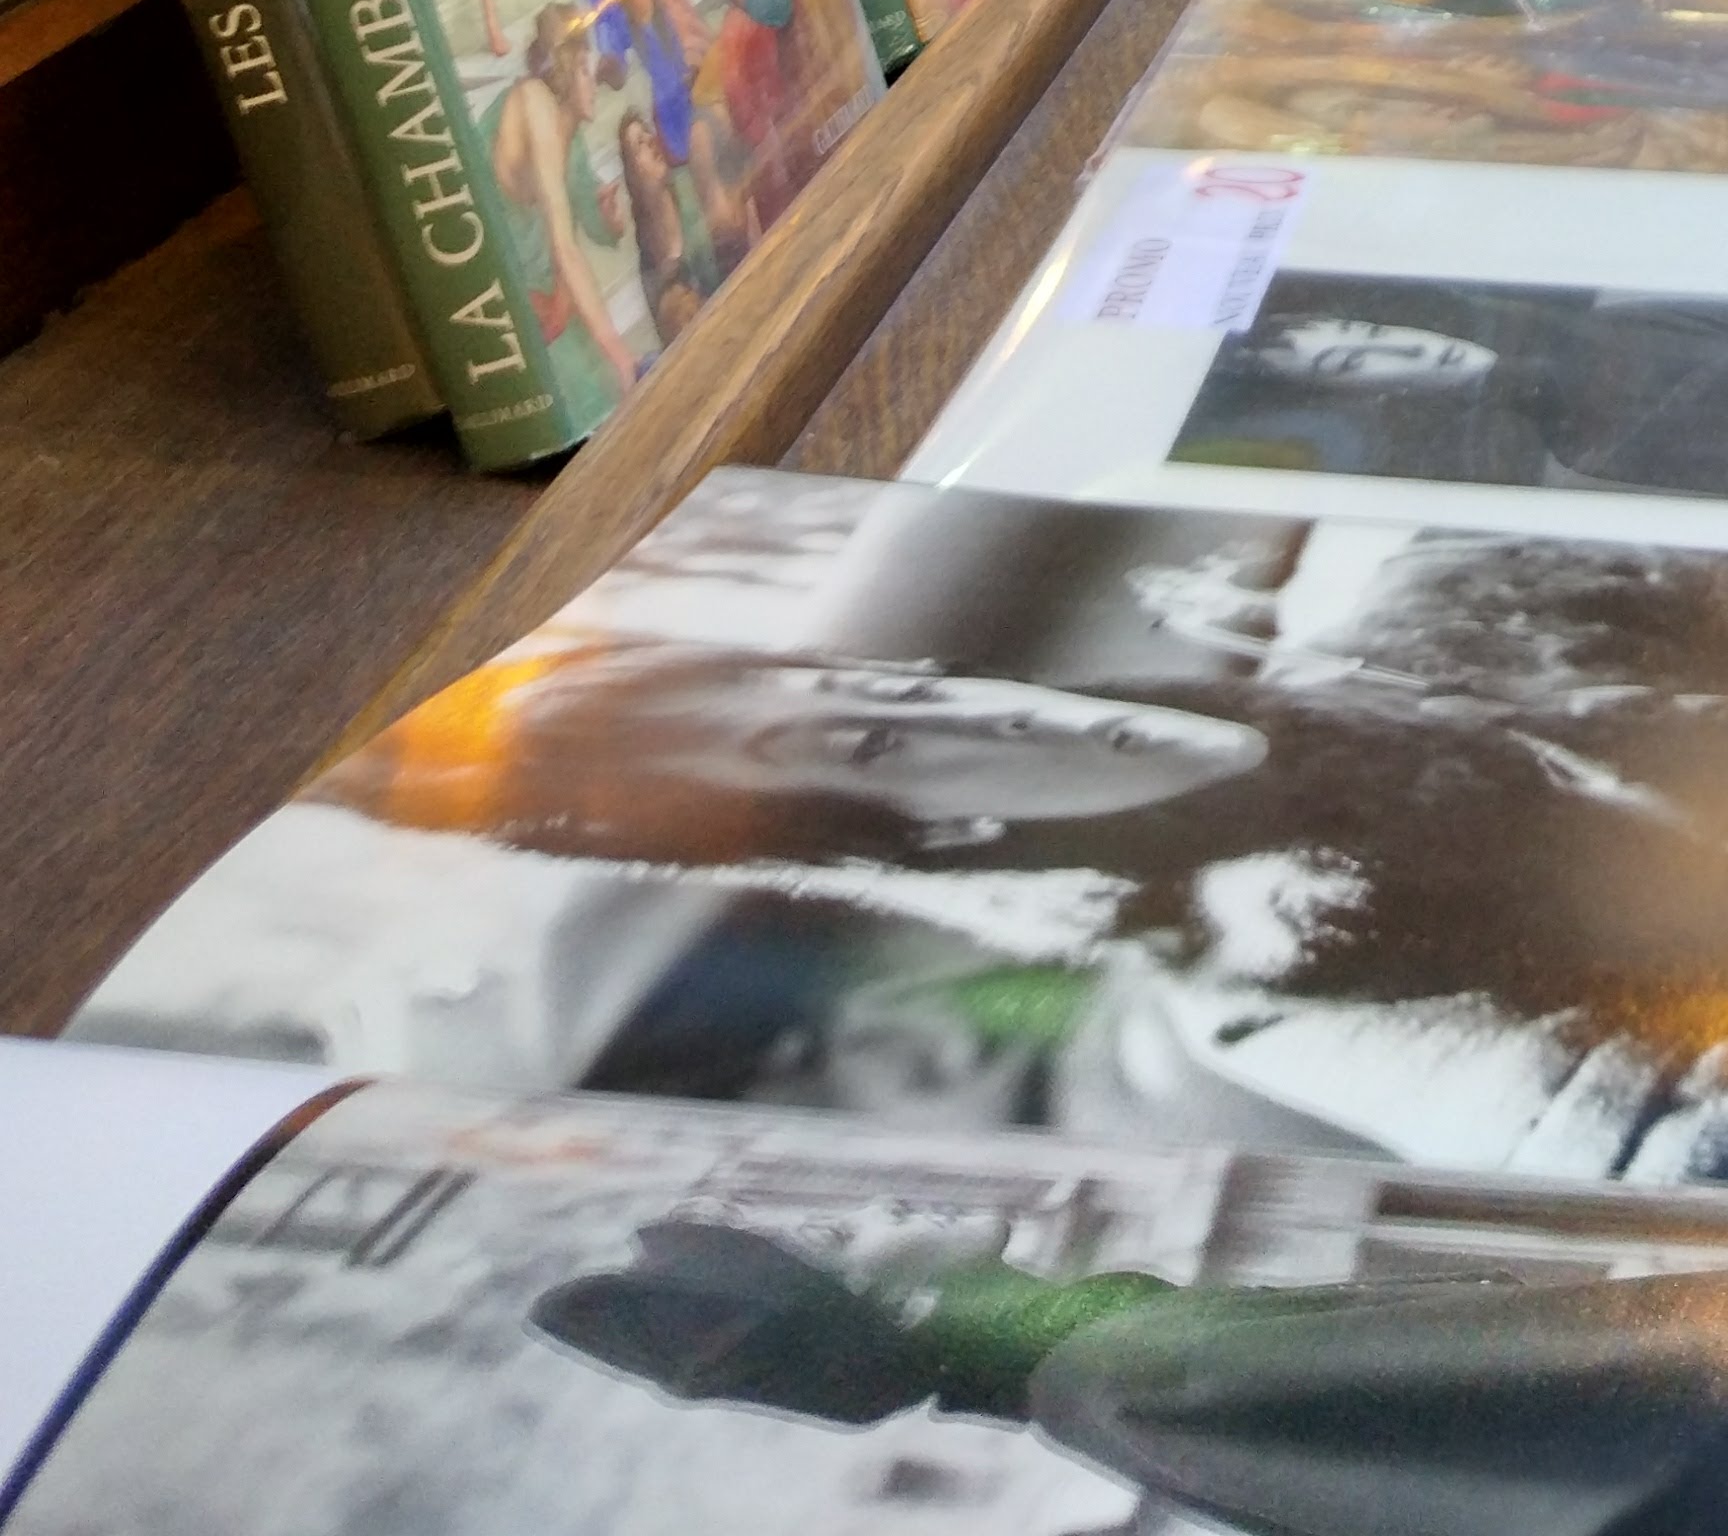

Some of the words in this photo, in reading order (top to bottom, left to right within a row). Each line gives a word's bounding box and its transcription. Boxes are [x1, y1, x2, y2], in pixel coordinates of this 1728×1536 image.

[208, 1, 288, 116] LES
[449, 278, 527, 386] LA
[1097, 236, 1173, 320] PROMO
